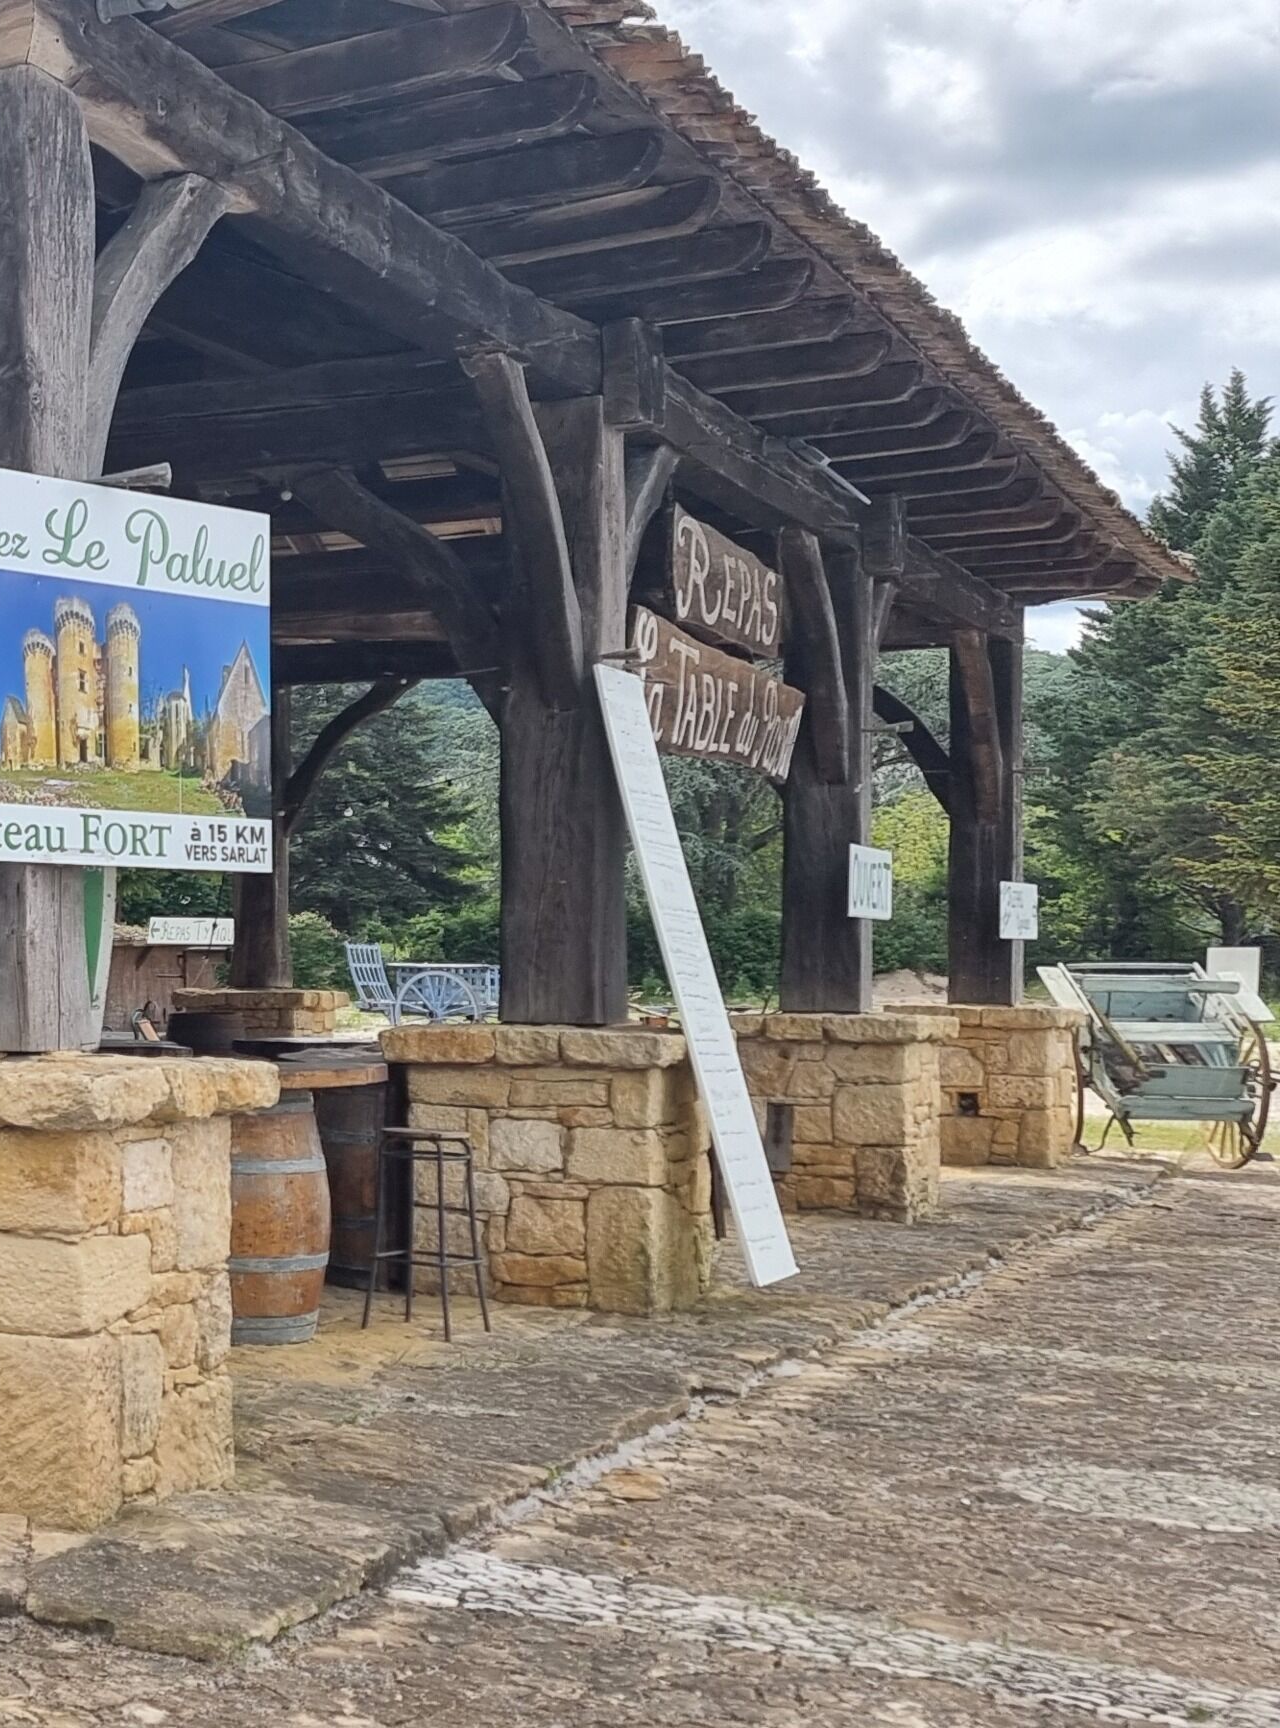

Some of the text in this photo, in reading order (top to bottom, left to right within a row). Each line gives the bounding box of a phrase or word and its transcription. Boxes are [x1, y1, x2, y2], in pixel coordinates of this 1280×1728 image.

[42, 499, 110, 570] Le
[125, 509, 265, 593] Paluel
[669, 637, 738, 753] TABLE
[735, 673, 759, 757] du
[79, 813, 172, 857] FORT
[184, 844, 268, 864] VERS SARLAT
[190, 821, 266, 846] à 15 KM
